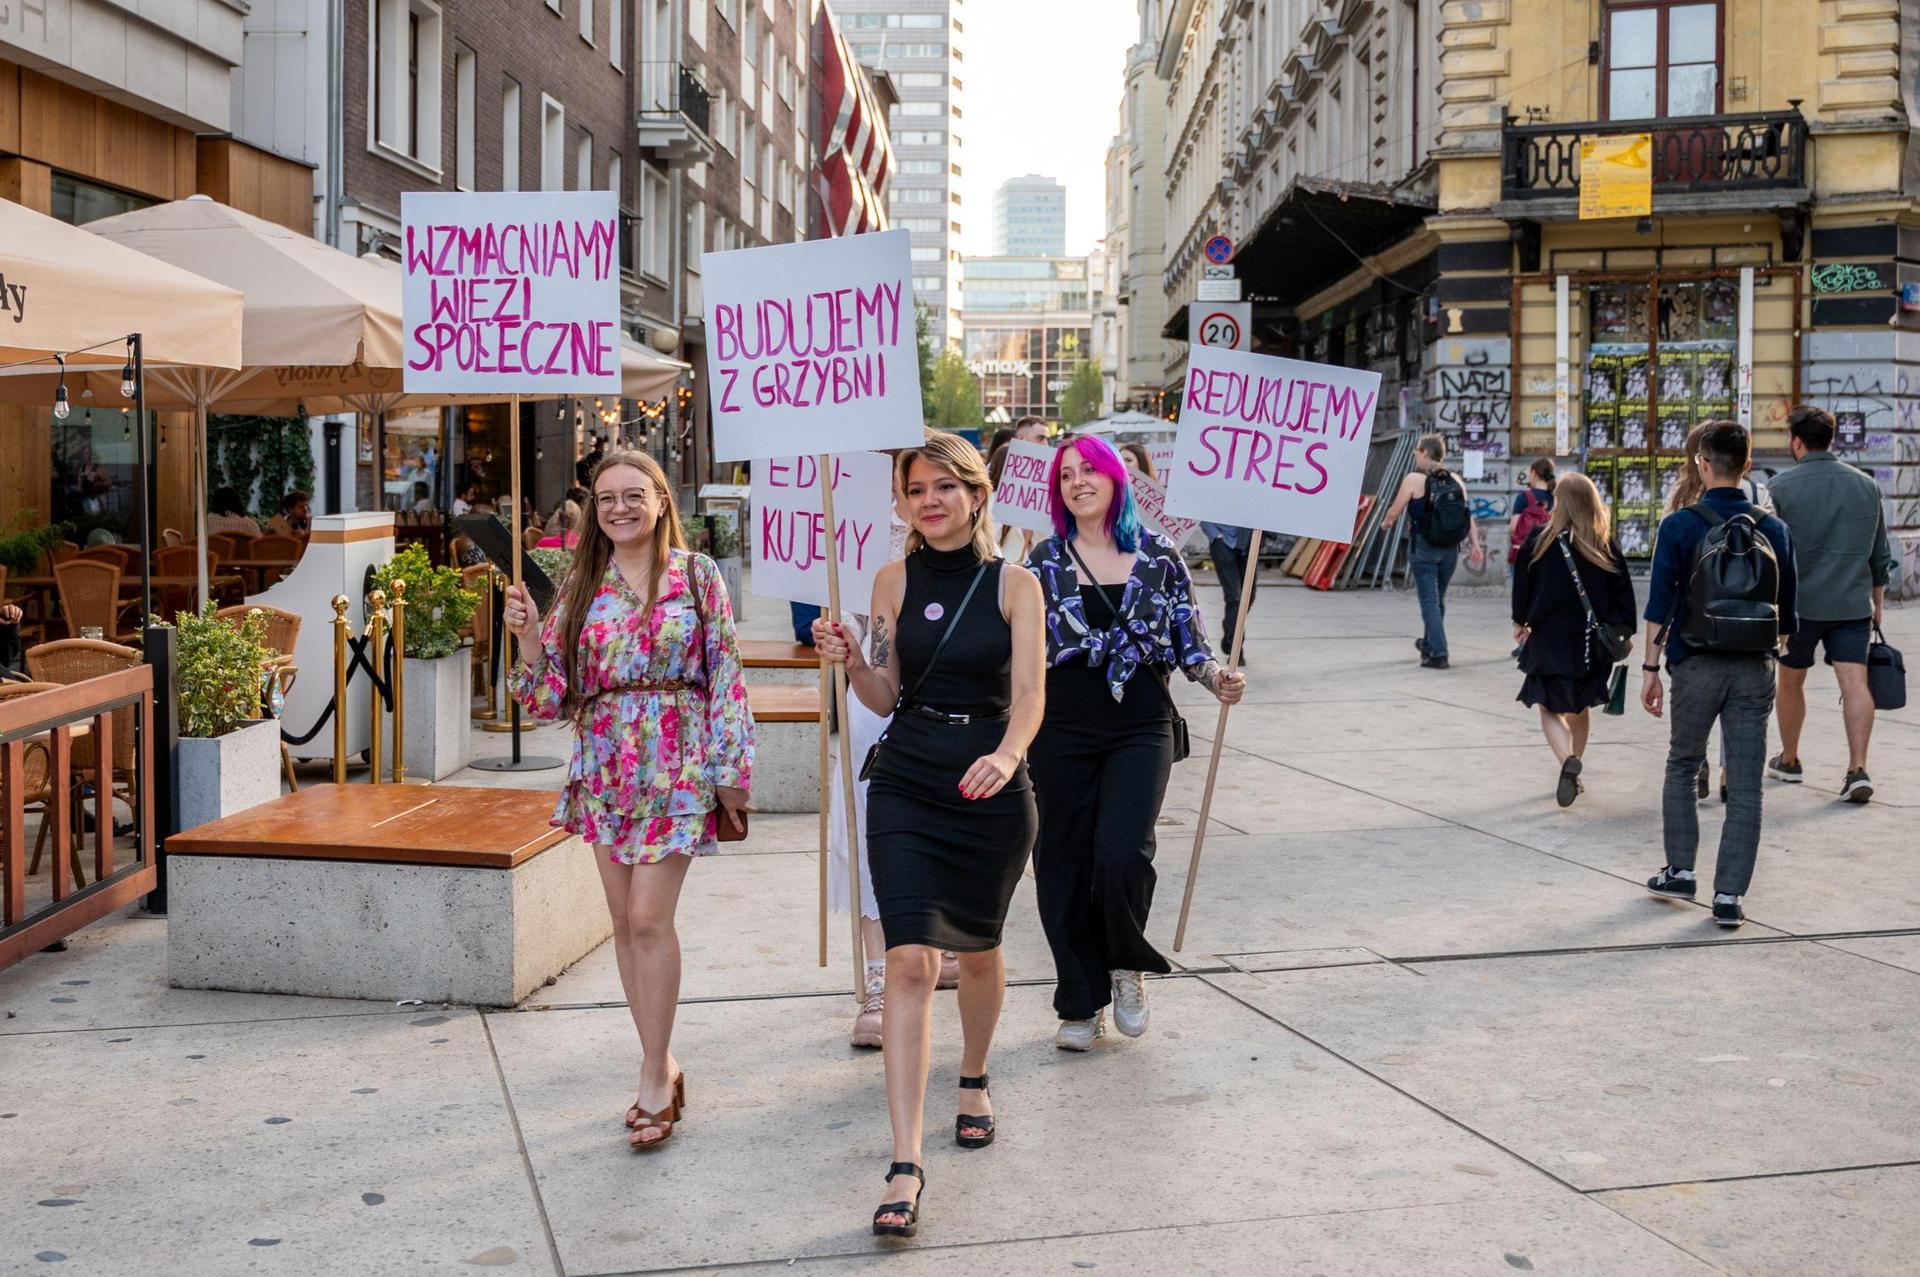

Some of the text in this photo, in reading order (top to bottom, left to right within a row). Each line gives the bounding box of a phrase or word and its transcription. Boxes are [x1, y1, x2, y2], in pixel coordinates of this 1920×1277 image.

[405, 219, 616, 281] WZMACNIAMY
[408, 320, 615, 377] SPOŁECZNE
[715, 280, 902, 361] BUDUJEMY
[1207, 323, 1236, 344] 20
[719, 352, 886, 413] Z GRZYBNI
[1187, 367, 1375, 442] REDUKUJEMY
[1187, 425, 1329, 496] STRES
[996, 482, 1016, 504] DO
